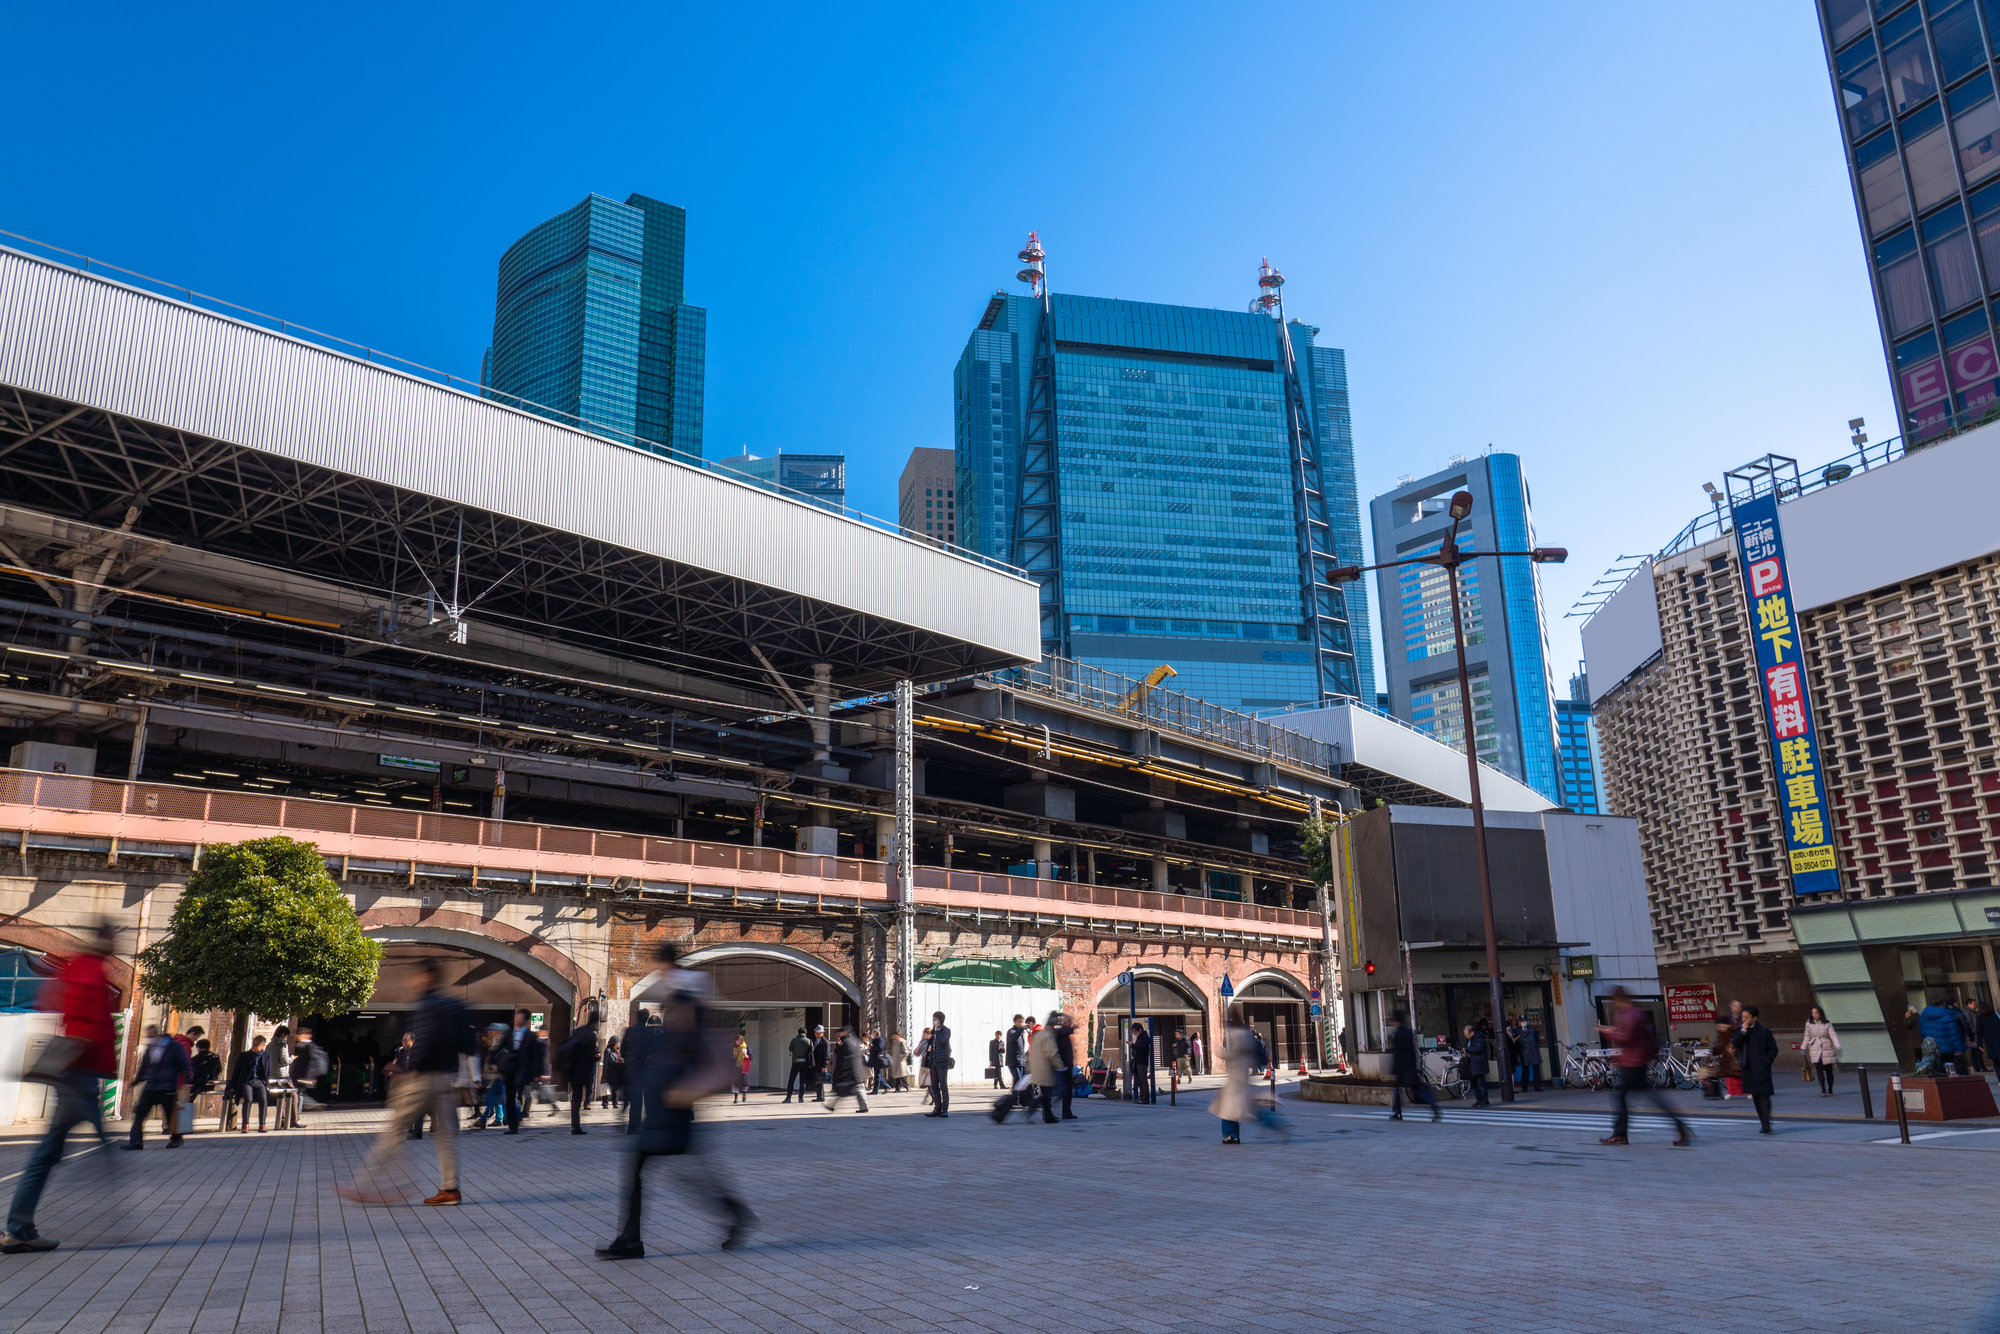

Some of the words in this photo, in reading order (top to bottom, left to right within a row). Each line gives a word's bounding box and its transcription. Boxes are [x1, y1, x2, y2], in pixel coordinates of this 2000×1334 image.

[1742, 518, 1772, 536] ニュー
[1744, 527, 1774, 549] 新橋
[1747, 543, 1776, 562] ビル
[1793, 848, 1830, 859] お問い合わせ先
[1795, 859, 1832, 871] 03-3504-1271
[1572, 968, 1593, 976] KOBAN
